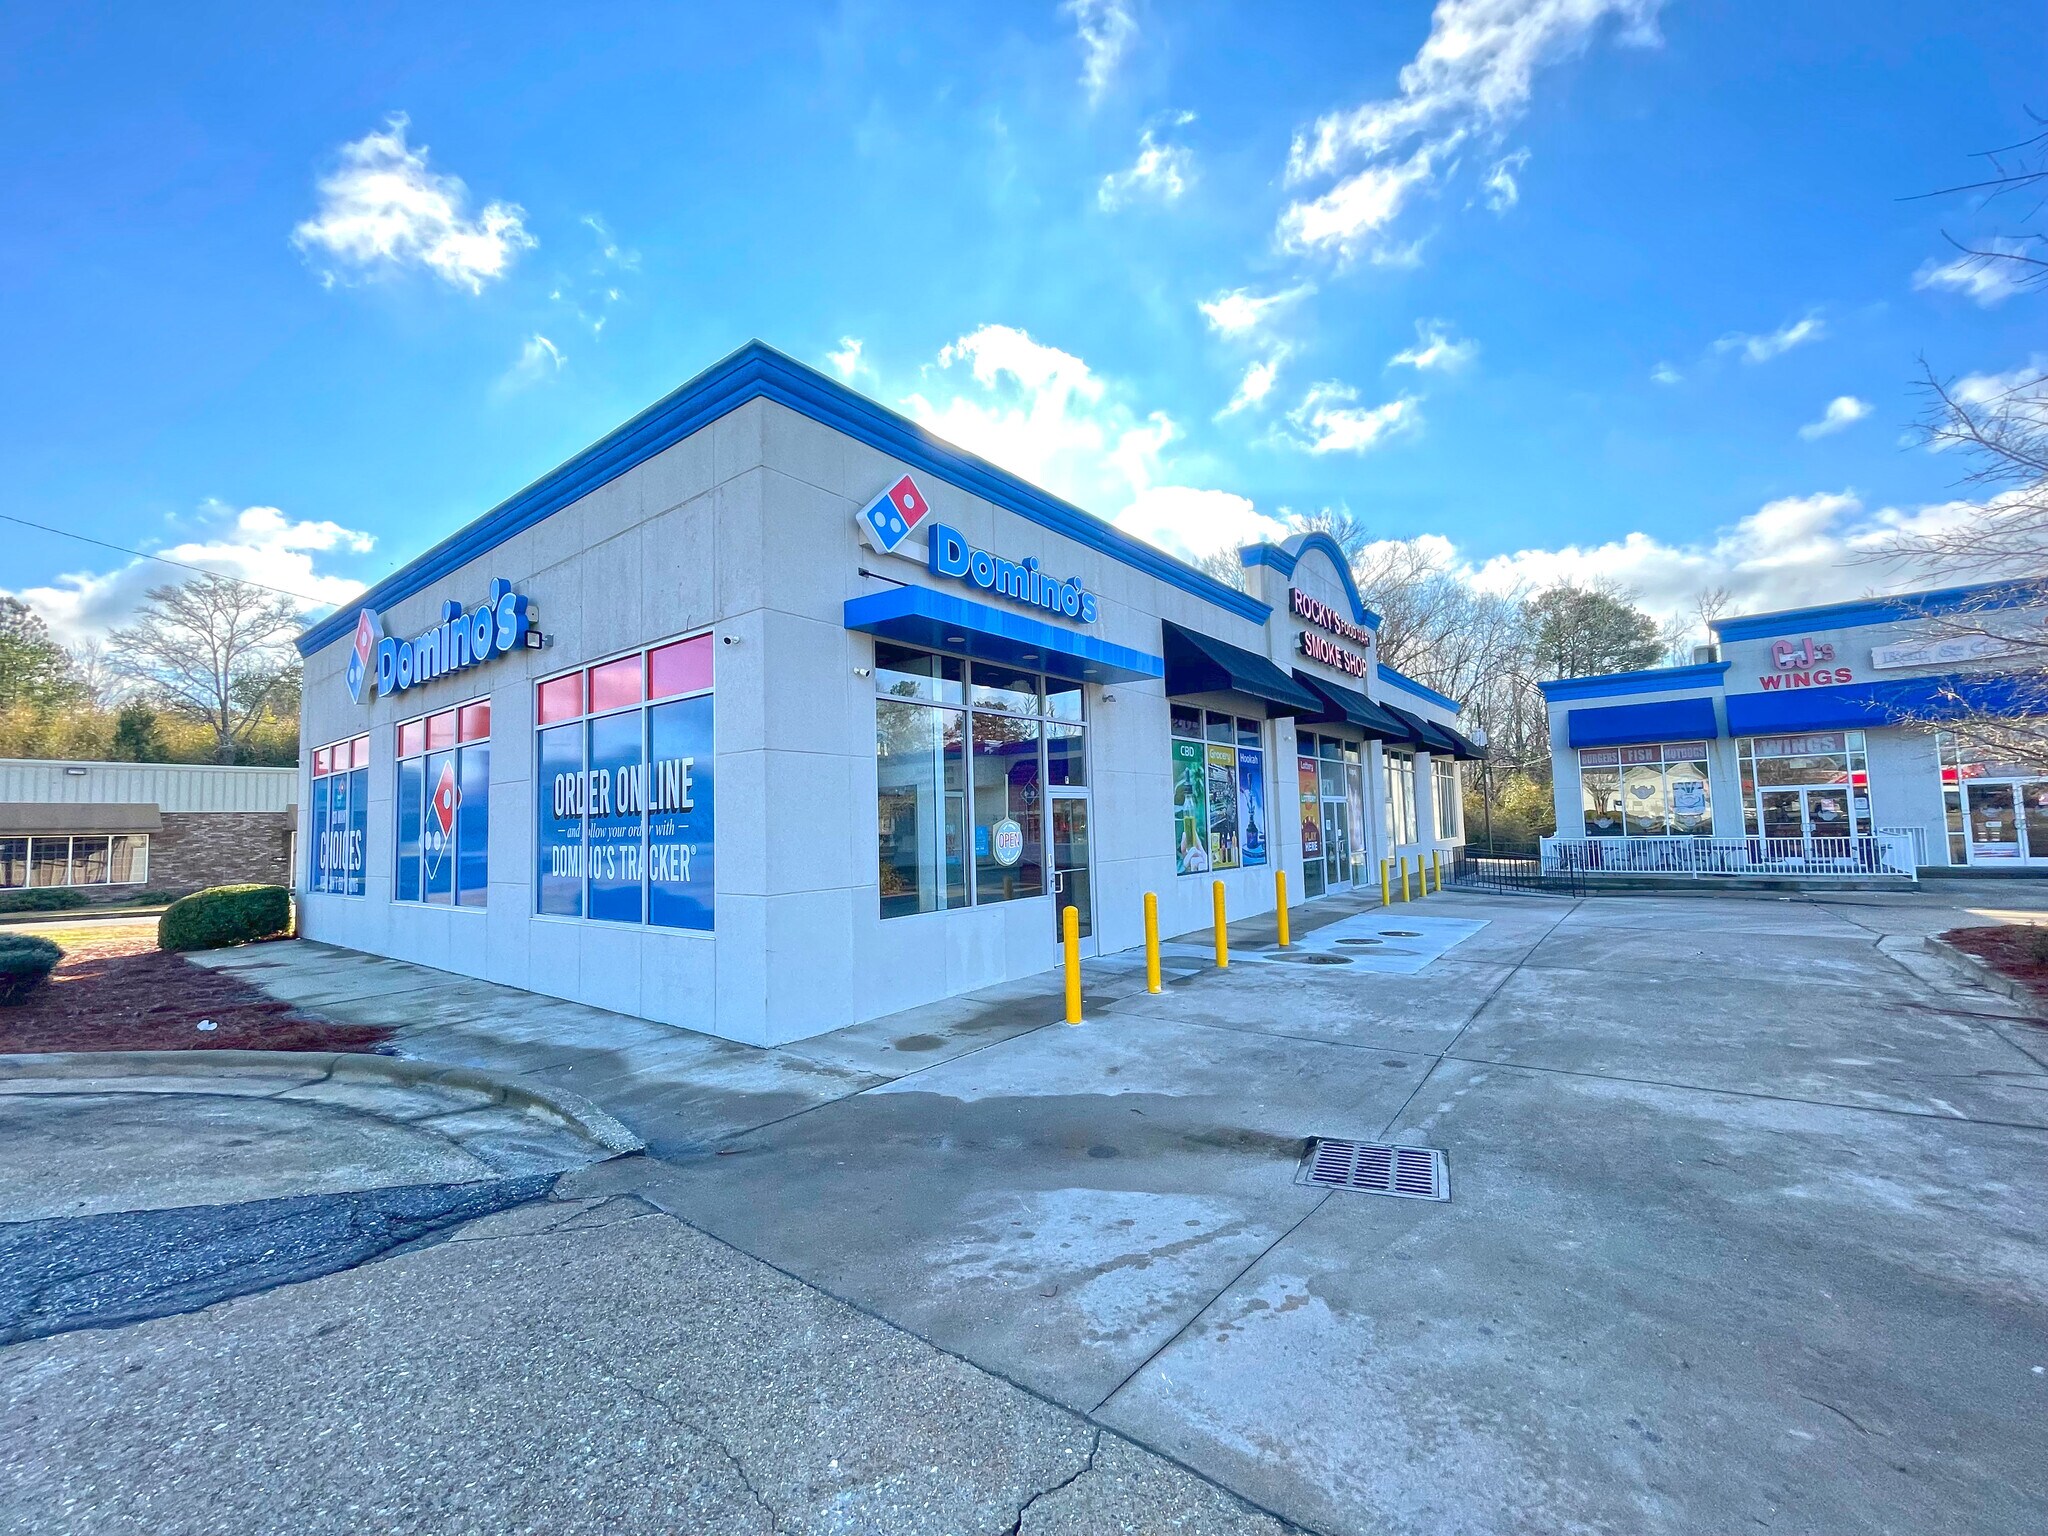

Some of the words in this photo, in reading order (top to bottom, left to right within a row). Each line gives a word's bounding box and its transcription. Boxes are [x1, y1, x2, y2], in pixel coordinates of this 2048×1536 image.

[934, 521, 1099, 624] Domino's
[1291, 587, 1341, 635] ROCKY'S
[377, 576, 530, 699] Domino's
[1301, 630, 1343, 669] SMOKE
[1342, 649, 1367, 678] SHOP
[1759, 667, 1853, 690] WINGS
[1180, 745, 1195, 757] CBD
[1209, 748, 1232, 763] Grocery
[1239, 753, 1259, 765] Hookah
[1581, 752, 1618, 765] BURGERS
[1628, 748, 1653, 762] FISH
[554, 768, 611, 818] ORDER
[616, 757, 695, 817] ONLINE
[566, 822, 582, 838] and
[606, 827, 626, 842] your
[627, 820, 654, 838] ordr
[655, 818, 675, 836] with
[998, 831, 1020, 849] OPEN
[1305, 841, 1318, 852] HERE
